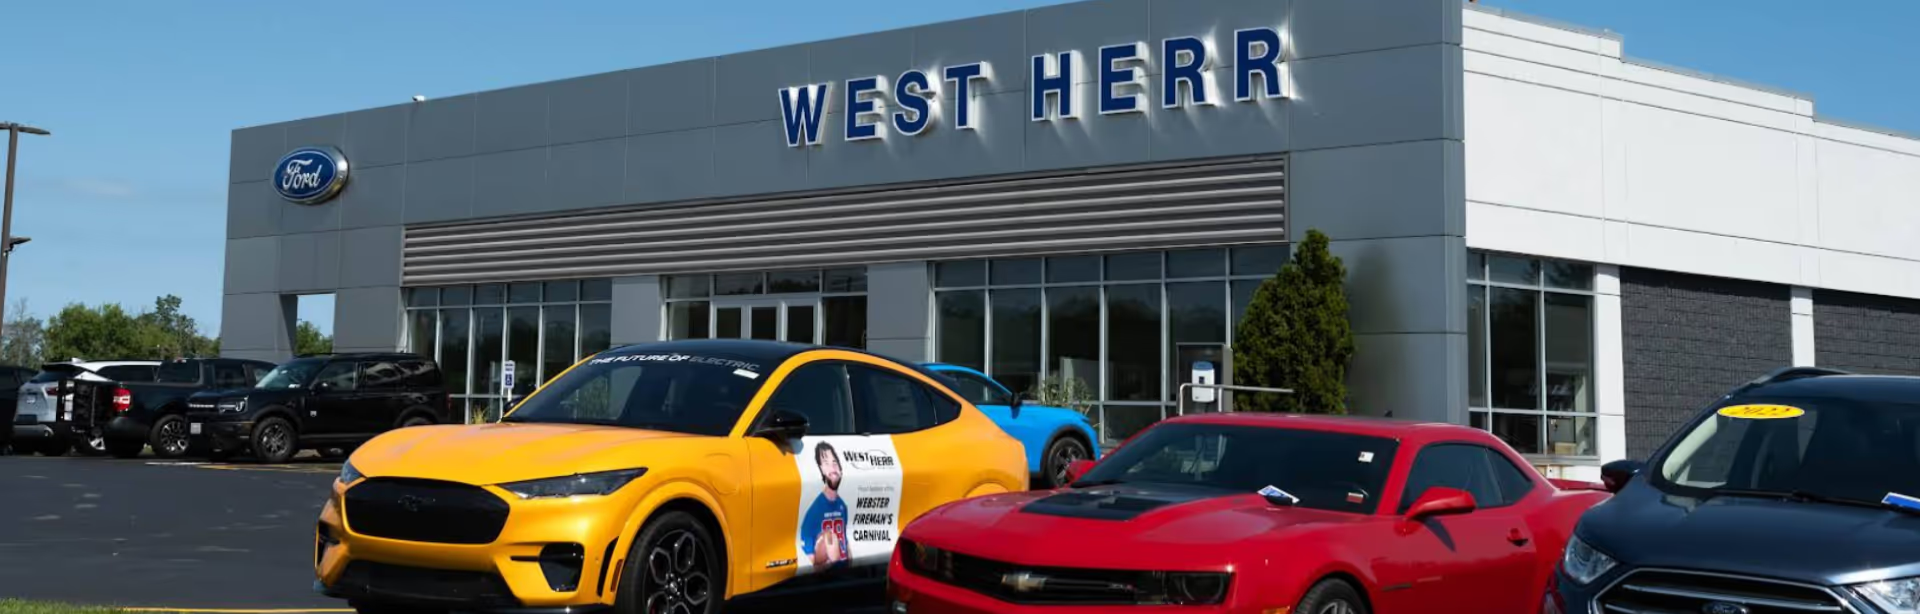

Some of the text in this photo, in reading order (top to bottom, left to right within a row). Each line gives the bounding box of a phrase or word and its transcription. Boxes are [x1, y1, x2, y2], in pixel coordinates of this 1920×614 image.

[778, 26, 1288, 147] WEST HERR
[282, 159, 323, 190] Ford
[588, 353, 761, 372] THE FUTURE OF ELECTRIC
[843, 450, 894, 466] WEST HERR
[856, 497, 889, 509] WEBSTER
[852, 513, 894, 525] FIREMAN'S
[853, 529, 892, 541] CARNIVAL
